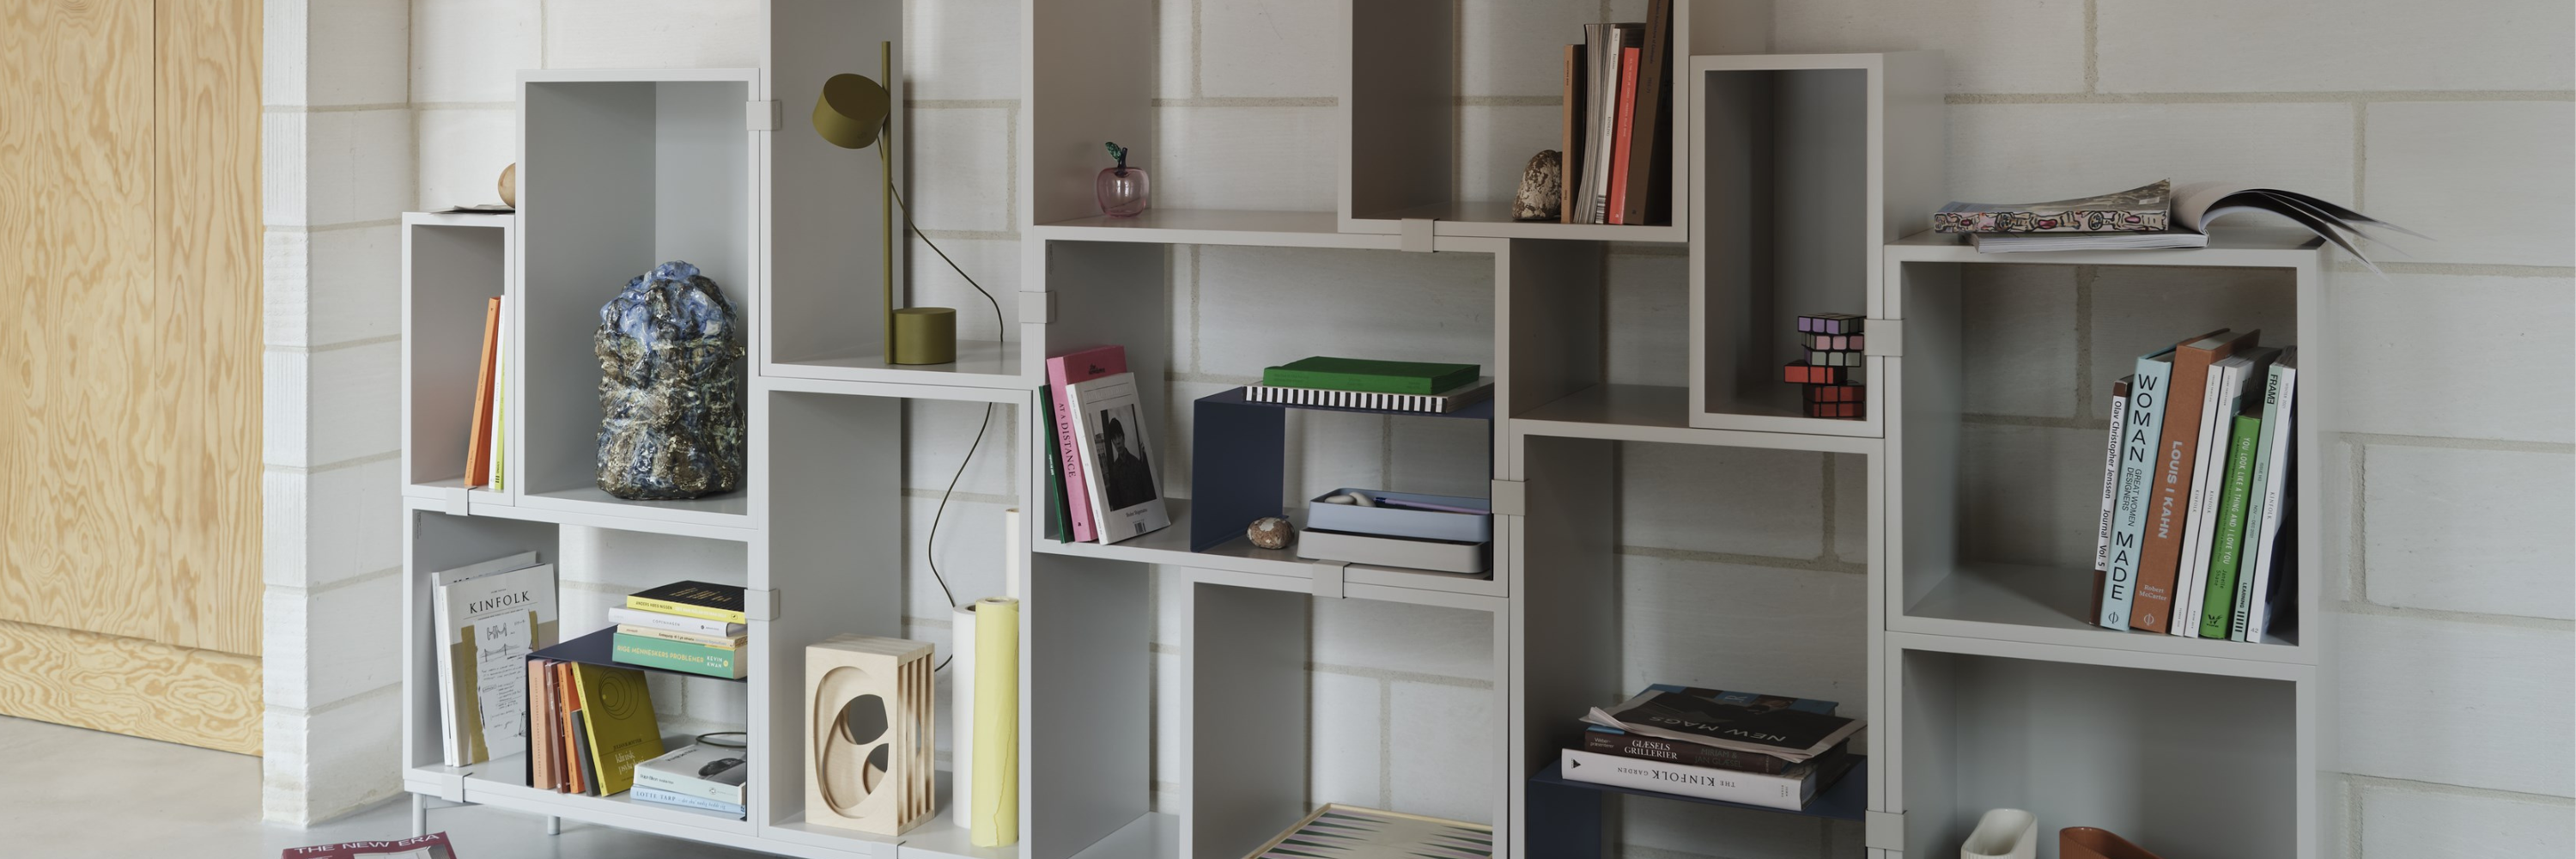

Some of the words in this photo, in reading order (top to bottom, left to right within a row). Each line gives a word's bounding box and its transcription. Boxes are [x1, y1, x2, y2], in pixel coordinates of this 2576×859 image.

[2267, 374, 2278, 405] FRAME
[1059, 403, 1065, 412] AT
[2113, 400, 2122, 419] Olav
[2129, 373, 2158, 463] WOMAN
[1061, 422, 1077, 478] DISTANCE
[2109, 421, 2120, 467] Christopher
[2242, 436, 2251, 450] YOU
[2167, 440, 2183, 484] LOUIS
[2239, 452, 2248, 470] LOOK
[2105, 468, 2115, 499] Jenssen
[2123, 466, 2135, 511] DESIGNERS
[2133, 468, 2142, 495] GREAT
[2233, 493, 2241, 511] THING
[2128, 496, 2138, 527] WOMEN
[2159, 496, 2173, 539] KAHN
[2101, 509, 2111, 539] Journal
[2226, 533, 2234, 550] LOVE
[2099, 545, 2107, 559] Vol.
[2111, 530, 2135, 601] MADE
[2139, 590, 2167, 600] McCarter
[2144, 584, 2165, 594] Robert
[470, 590, 530, 614] KINFOLK
[631, 647, 669, 658] MENNESKERS
[669, 653, 704, 663] PROBLEMER
[1649, 716, 1719, 731] MAGS
[1724, 729, 1787, 742] NEW
[1624, 746, 1678, 759] GRILLERIER
[1631, 739, 1671, 751] GLÆSELS
[1701, 747, 1729, 758] MIRIAM
[615, 749, 635, 764] klinisk
[1712, 758, 1743, 768] GLÆSEL
[1617, 767, 1649, 776] GARDEN
[1652, 769, 1716, 787] KINFOLK
[636, 790, 657, 799] LOTTE
[660, 793, 676, 801] TARP
[294, 844, 336, 855] THE
[398, 834, 440, 847] ERA
